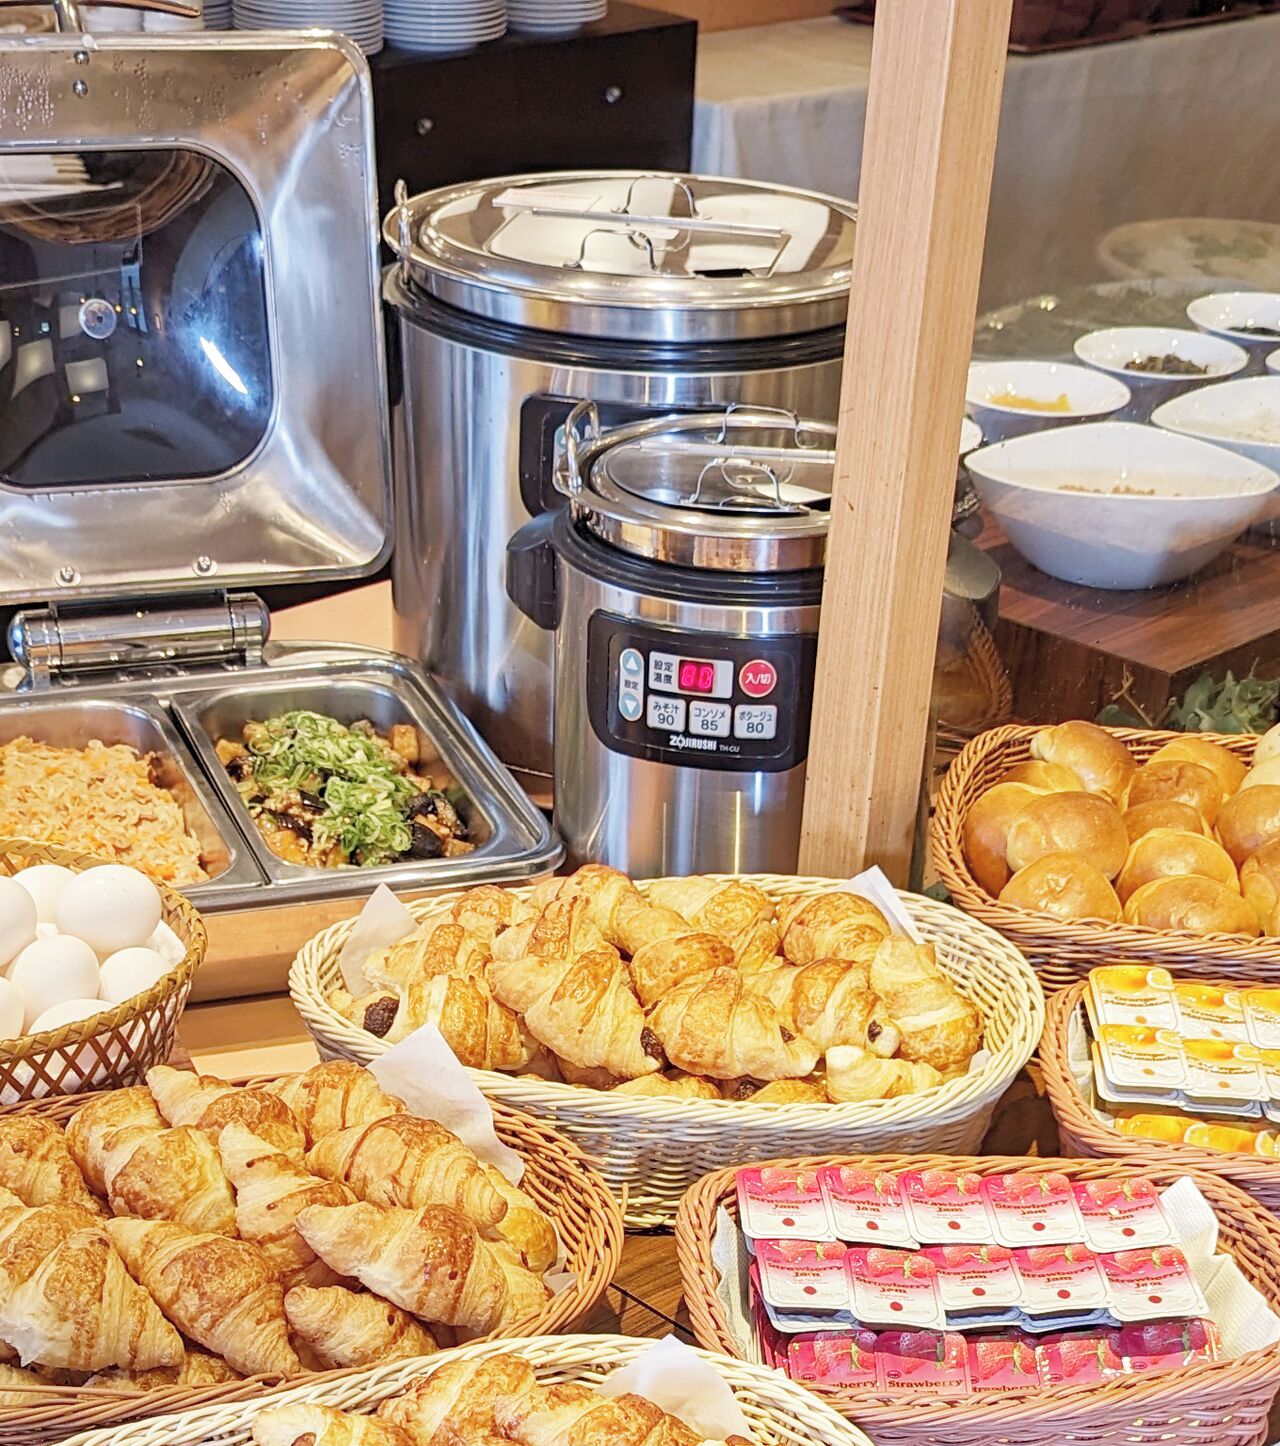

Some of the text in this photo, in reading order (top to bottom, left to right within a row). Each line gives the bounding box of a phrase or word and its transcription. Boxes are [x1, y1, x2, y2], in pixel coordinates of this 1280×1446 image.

[653, 660, 673, 672] 設定
[653, 672, 673, 685] 温度
[744, 672, 771, 685] 入/切
[653, 701, 680, 714] みそ汁
[694, 707, 726, 719] コンソメ
[657, 713, 675, 726] 90
[701, 719, 719, 731] 85
[746, 722, 765, 733] 80
[669, 734, 717, 751] ZOJIRUSHI
[994, 1199, 1069, 1210] Strawberry
[888, 1379, 963, 1389] Strawberry
